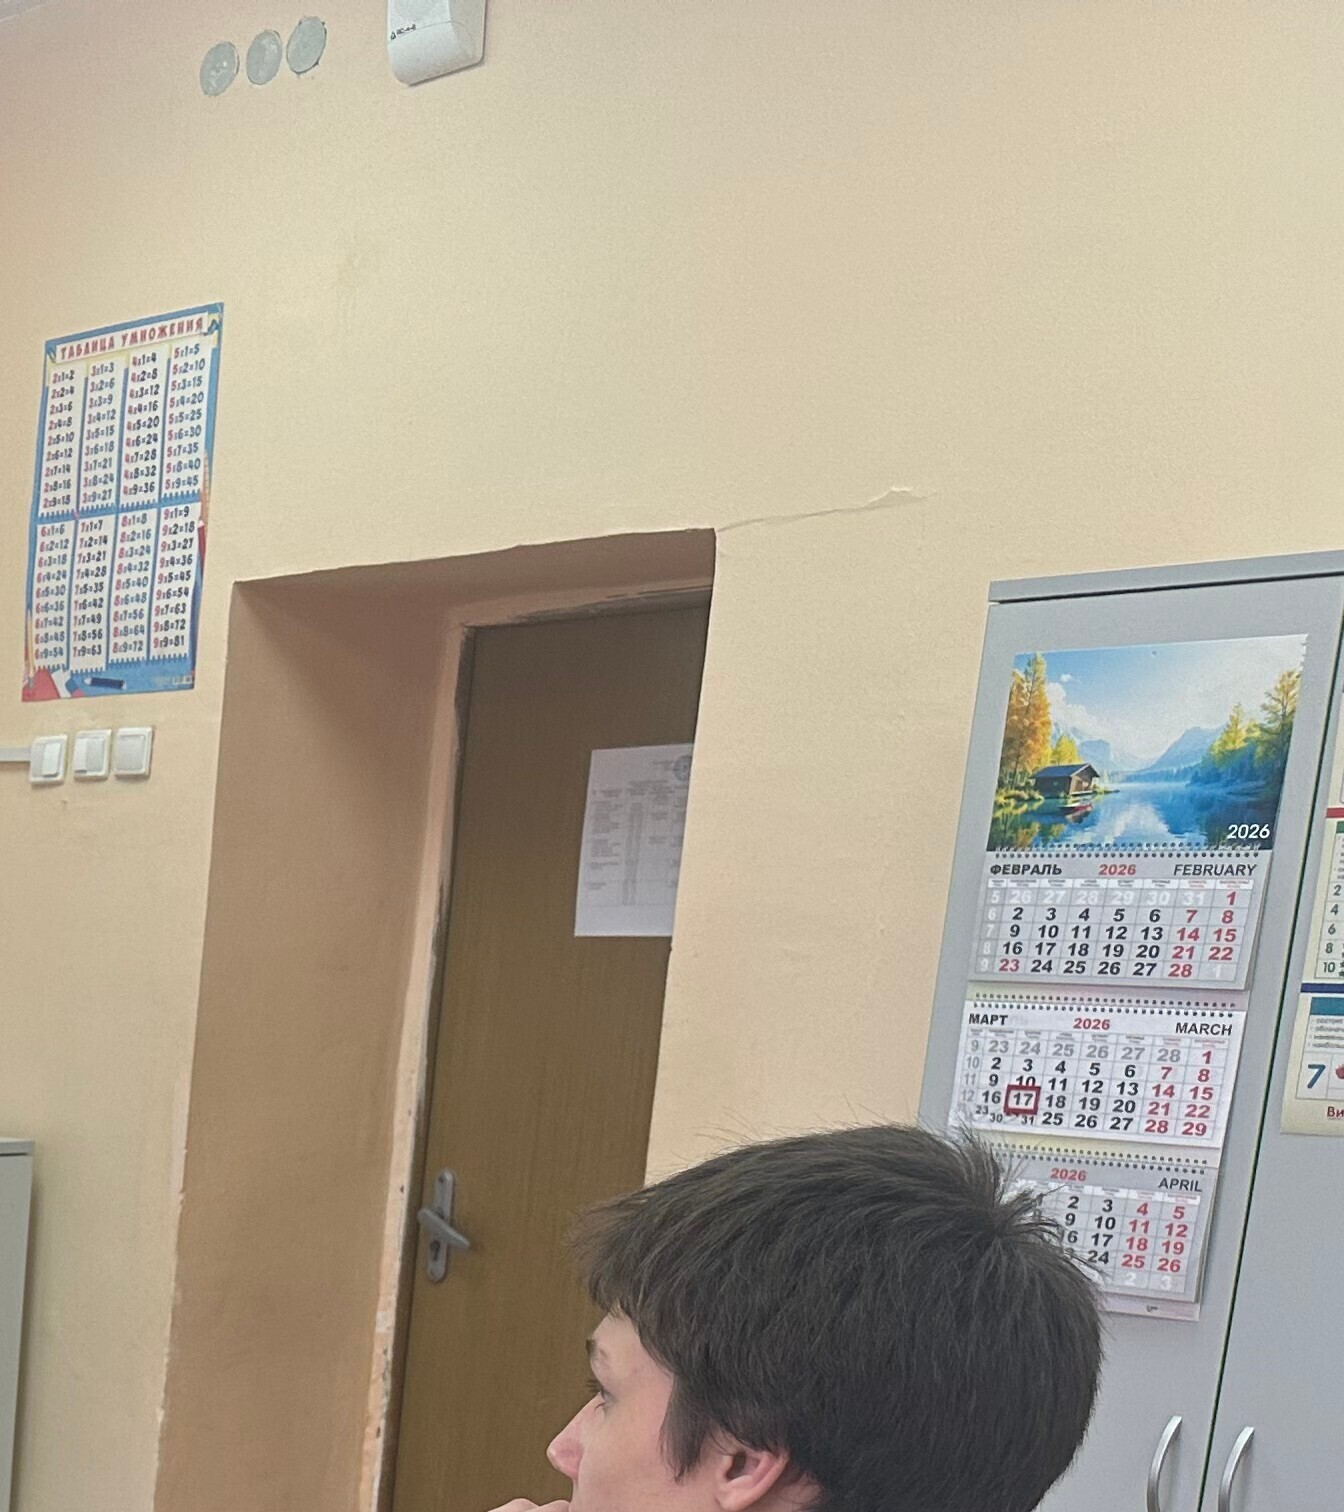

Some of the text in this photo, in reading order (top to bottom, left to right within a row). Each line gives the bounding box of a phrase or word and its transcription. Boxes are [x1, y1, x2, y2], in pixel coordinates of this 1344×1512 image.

[61, 317, 204, 360] ТАБЛИЦА УМНОЖЕНИЯ
[1228, 824, 1270, 839] 2026
[990, 864, 1257, 876] ФЕВРАЛЬ 2026 FEBRUARY
[1226, 892, 1236, 906] 1
[1333, 884, 1342, 896] 2
[1013, 908, 1233, 924] 2 3 4 5 6 7 8
[1330, 904, 1339, 915] 4
[1010, 924, 1236, 942] 9 10 11 12 13 14 15
[1328, 924, 1336, 935] 6
[1003, 942, 1233, 960] 16 17 18 19 20 21 22
[1325, 942, 1333, 954] 8
[999, 959, 1192, 977] 23 24 25 26 27 28
[1323, 962, 1336, 973] 10
[969, 1013, 1232, 1036] МАРТ 2026 MARCH
[1203, 1051, 1212, 1064] 1
[991, 1057, 1210, 1082] 2 3 4 5 6 7 8
[1307, 1064, 1326, 1089] 7
[989, 1074, 1212, 1100] 9 10 11 12 13 14 15
[982, 1091, 1210, 1118] 16 17 18 19 20 21 22
[1327, 1106, 1344, 1117] Ви
[976, 1105, 1207, 1136] 23 30 31 25 26 27 28 29
[1050, 1167, 1202, 1192] 2026 APRIL
[1068, 1196, 1185, 1219] 2 3 4 5
[1065, 1213, 1188, 1238] 9 10 11 12
[1091, 1233, 1113, 1247] 17
[1126, 1237, 1148, 1251] 18
[1162, 1241, 1184, 1255] 19
[1088, 1250, 1180, 1272] 24 25 26
